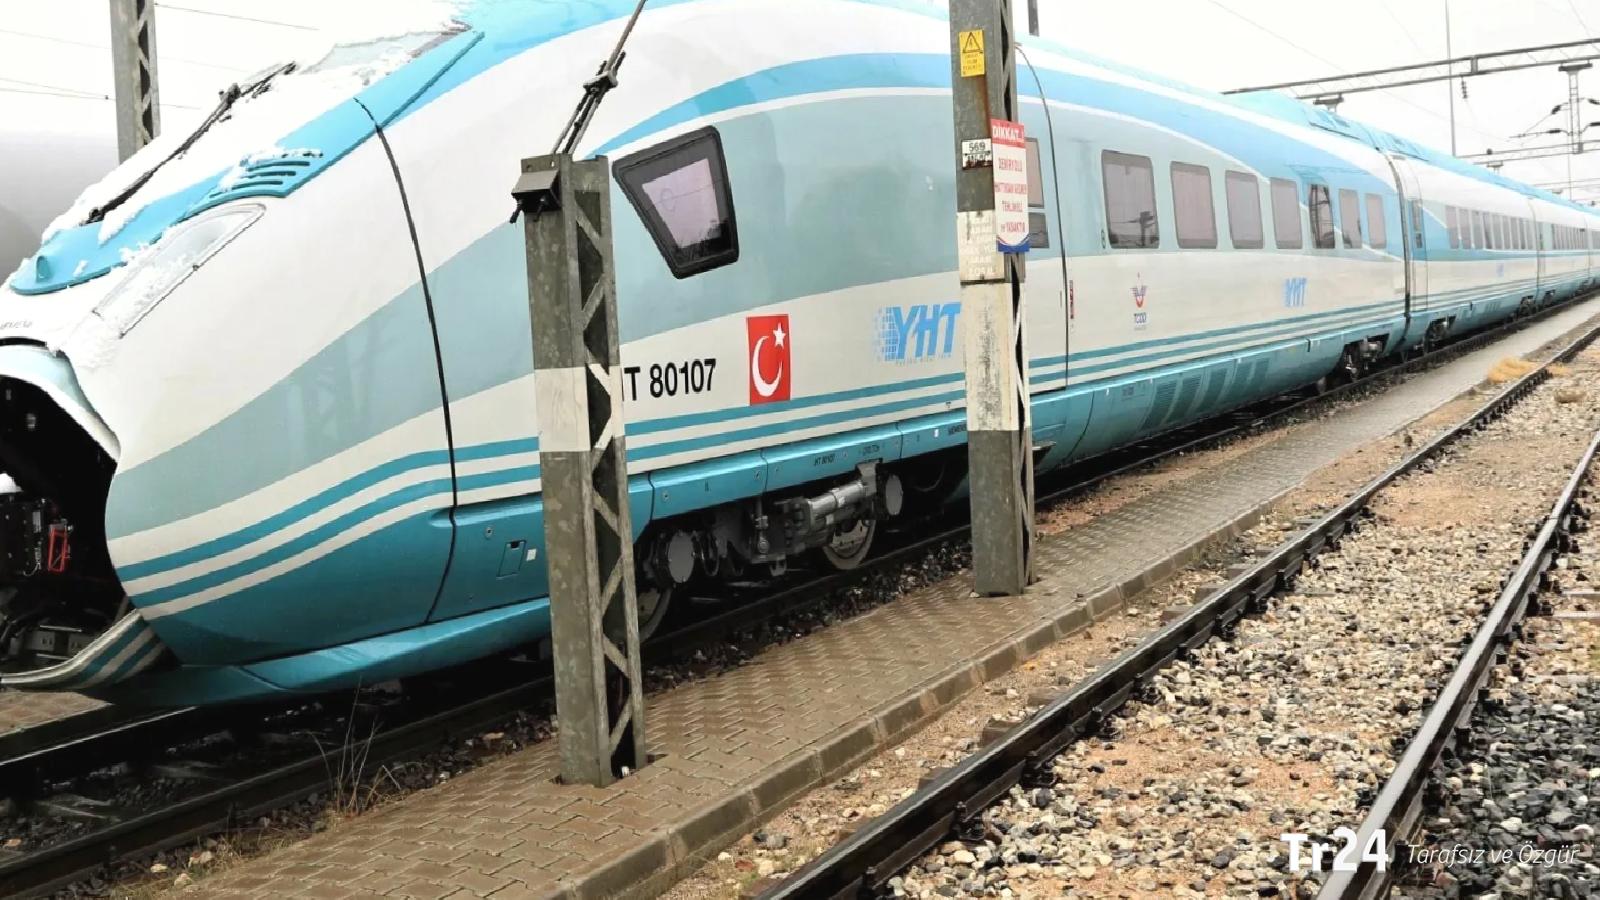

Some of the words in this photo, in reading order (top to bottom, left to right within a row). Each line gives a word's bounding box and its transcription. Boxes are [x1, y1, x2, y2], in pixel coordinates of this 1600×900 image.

[968, 141, 986, 152] 569
[891, 302, 962, 360] YHT
[649, 357, 717, 399] 80107
